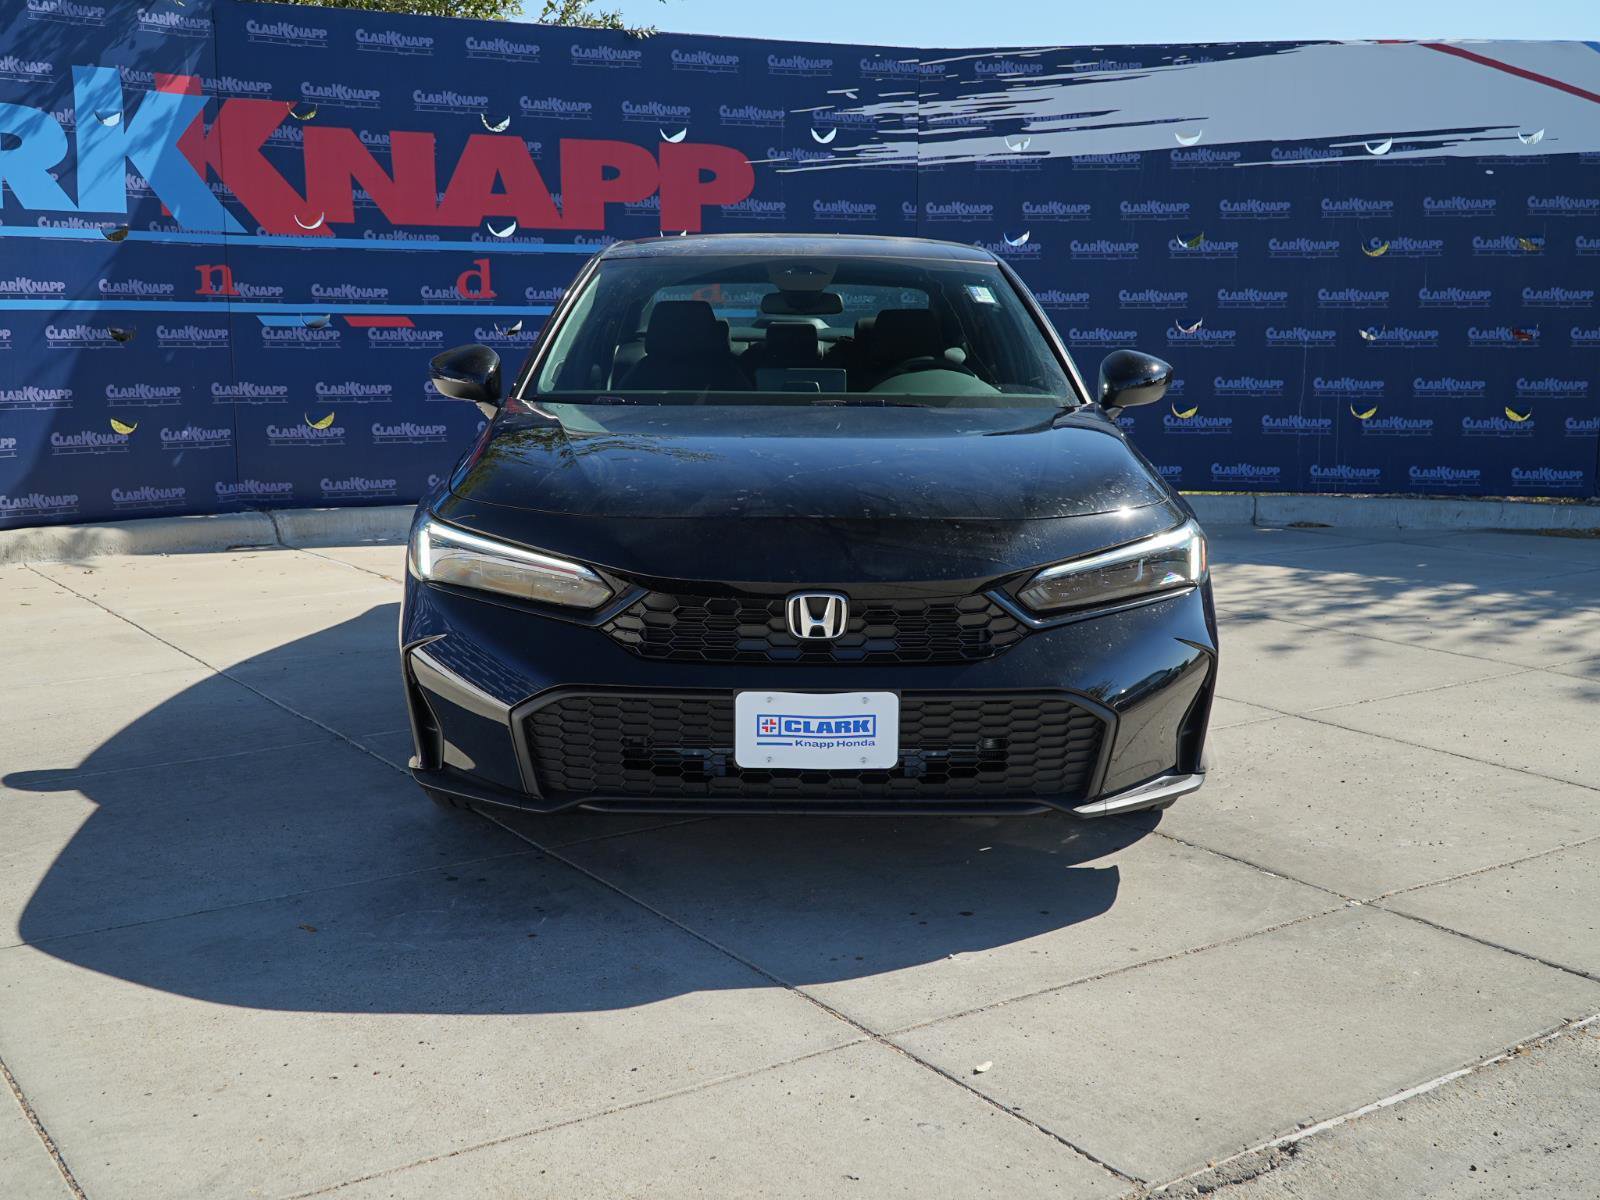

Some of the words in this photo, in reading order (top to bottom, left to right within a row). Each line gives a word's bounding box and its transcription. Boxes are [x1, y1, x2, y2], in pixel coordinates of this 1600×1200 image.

[785, 719, 870, 735] CLARK
[795, 740, 834, 749] Knapp
[836, 739, 875, 747] Honda
